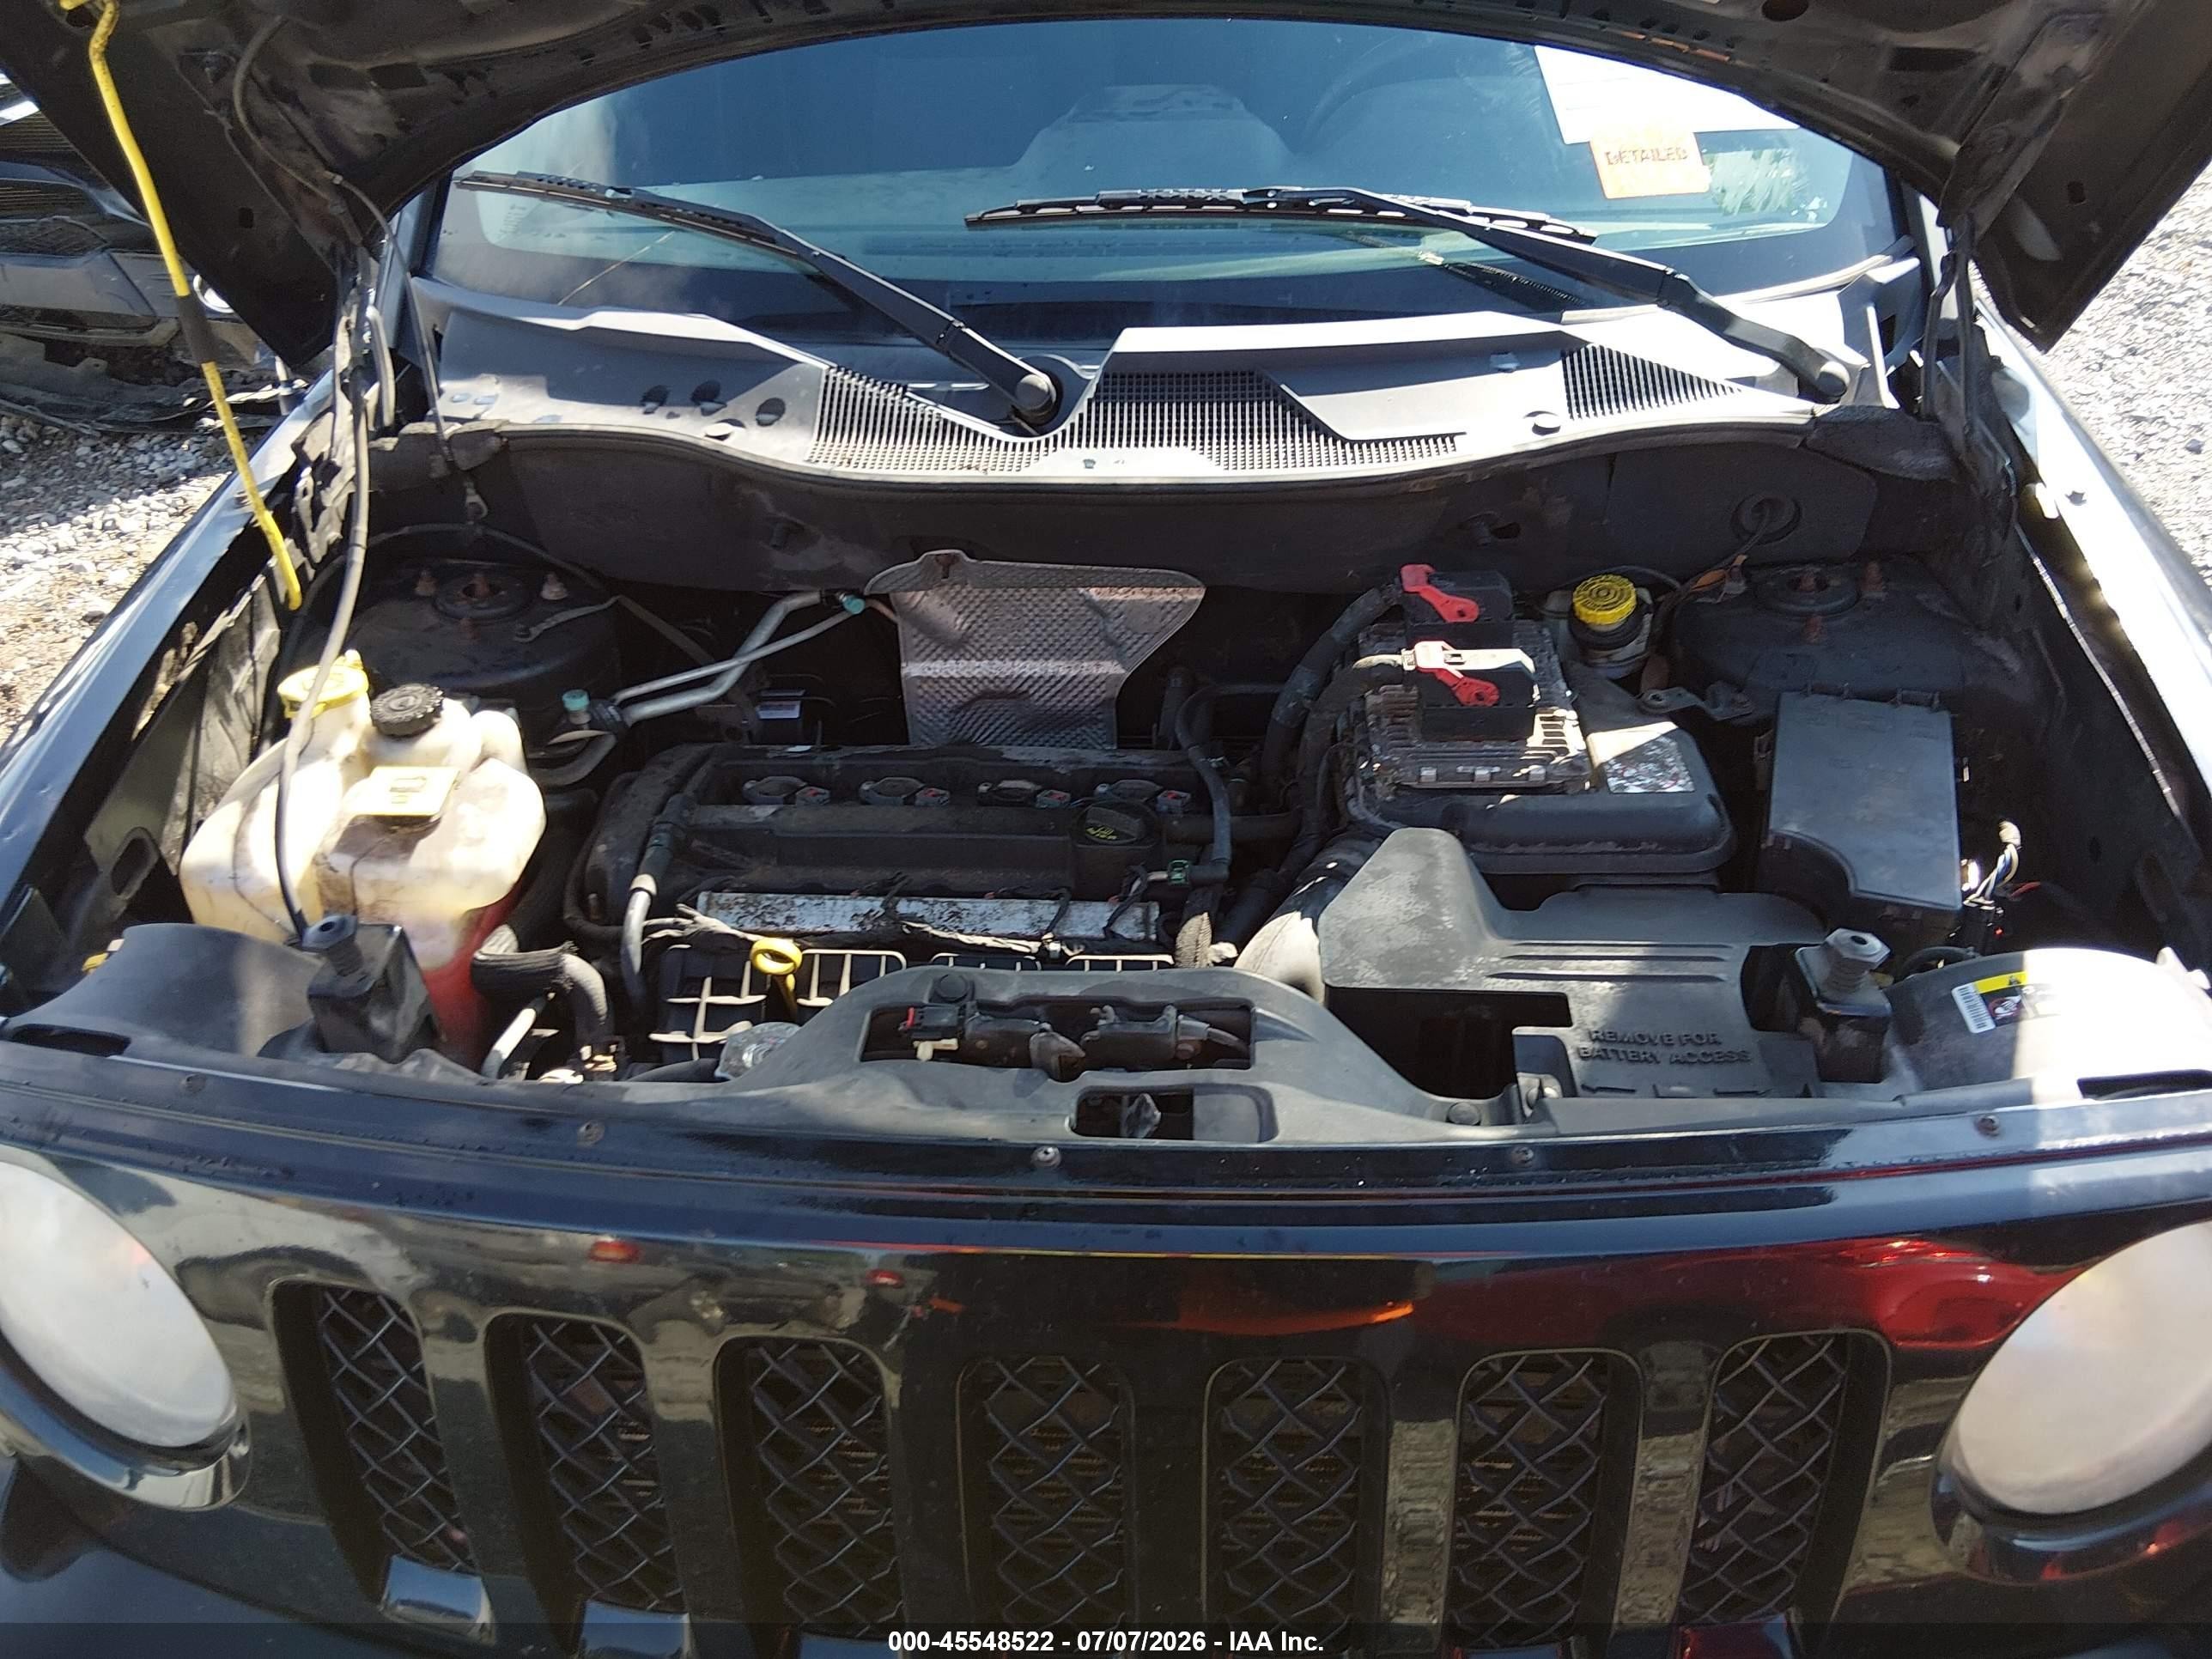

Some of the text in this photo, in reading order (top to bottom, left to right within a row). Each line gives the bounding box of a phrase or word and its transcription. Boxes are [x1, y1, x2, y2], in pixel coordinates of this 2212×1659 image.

[1604, 147, 1688, 166] DETAILED
[1589, 1030, 1722, 1046] REMOVE FOR
[1578, 1047, 1752, 1065] BATTERY ACCESS
